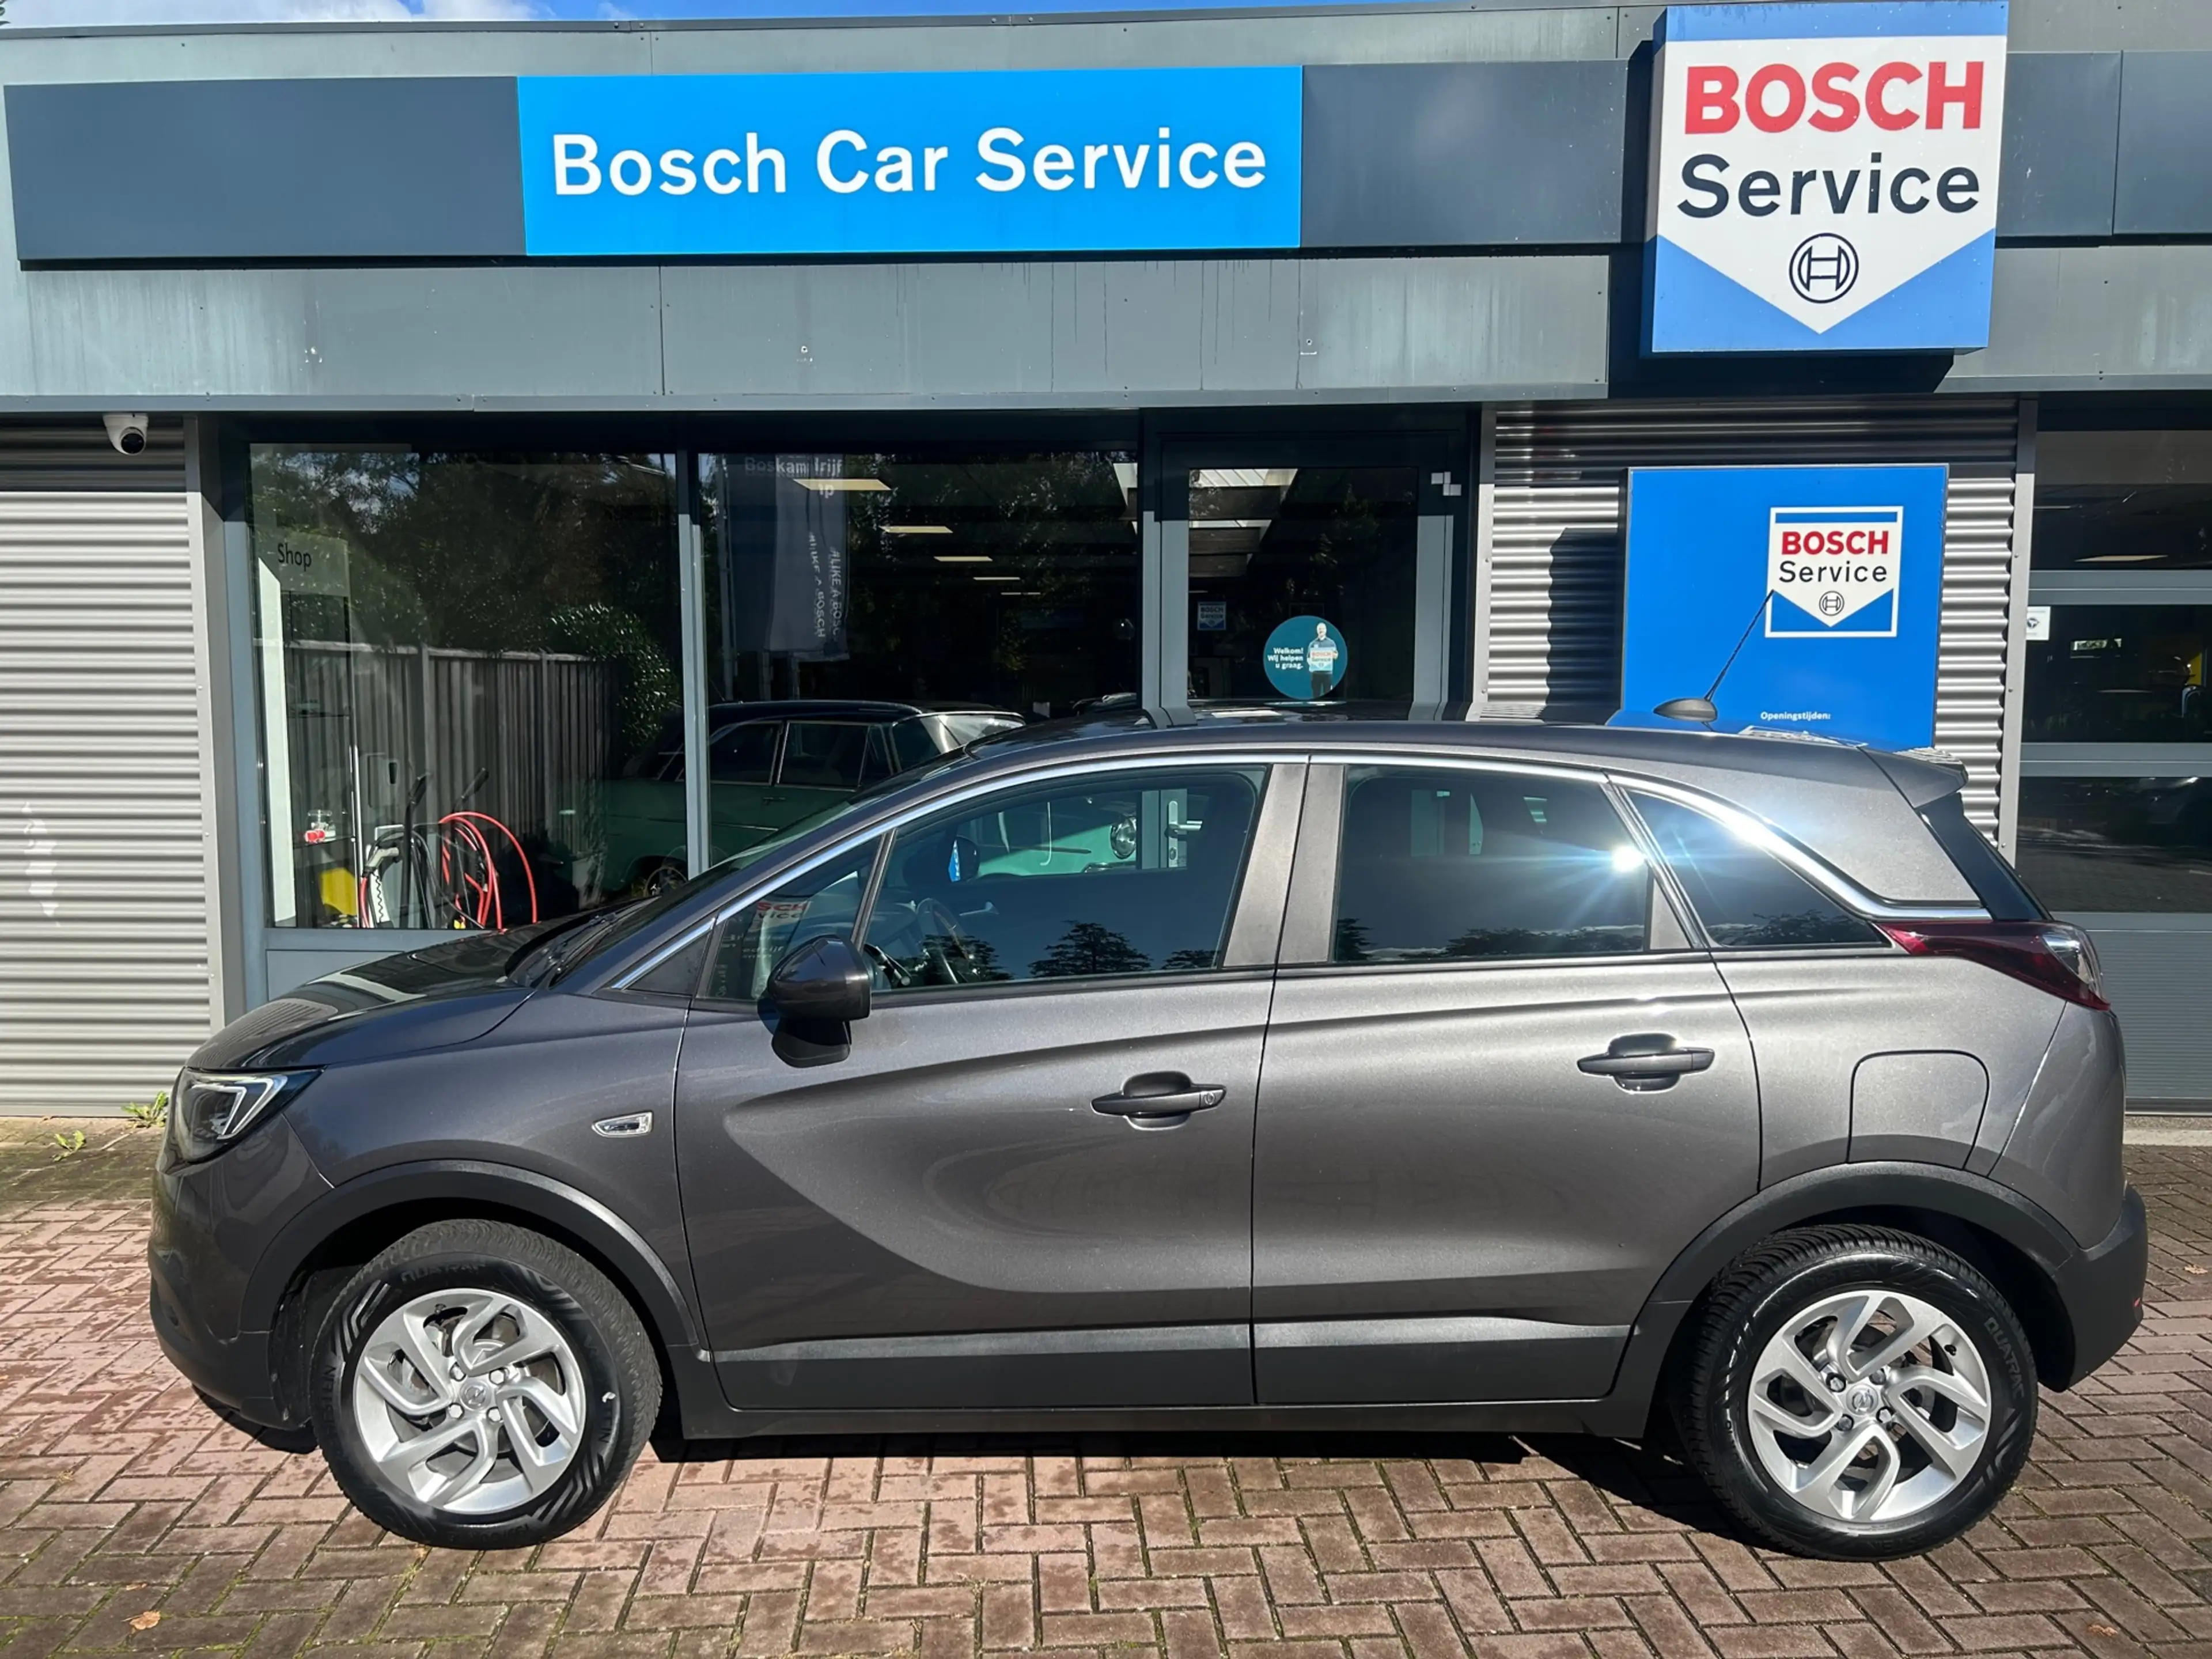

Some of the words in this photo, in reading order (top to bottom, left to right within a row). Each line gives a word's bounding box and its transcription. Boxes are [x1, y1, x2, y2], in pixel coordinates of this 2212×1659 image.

[1685, 61, 1984, 134] BOSCH
[553, 132, 786, 195] Bosch
[816, 129, 948, 193] Car
[976, 127, 1266, 191] Service
[1677, 152, 1979, 219] Service
[1782, 530, 1889, 555] BOSCH
[277, 543, 312, 571] Shop
[1778, 560, 1887, 584] Service
[1267, 654, 1279, 662] Wij
[1280, 654, 1304, 662] helpen
[1760, 711, 1831, 721] Openingstijden:
[1983, 1316, 2025, 1400] QUATRAC
